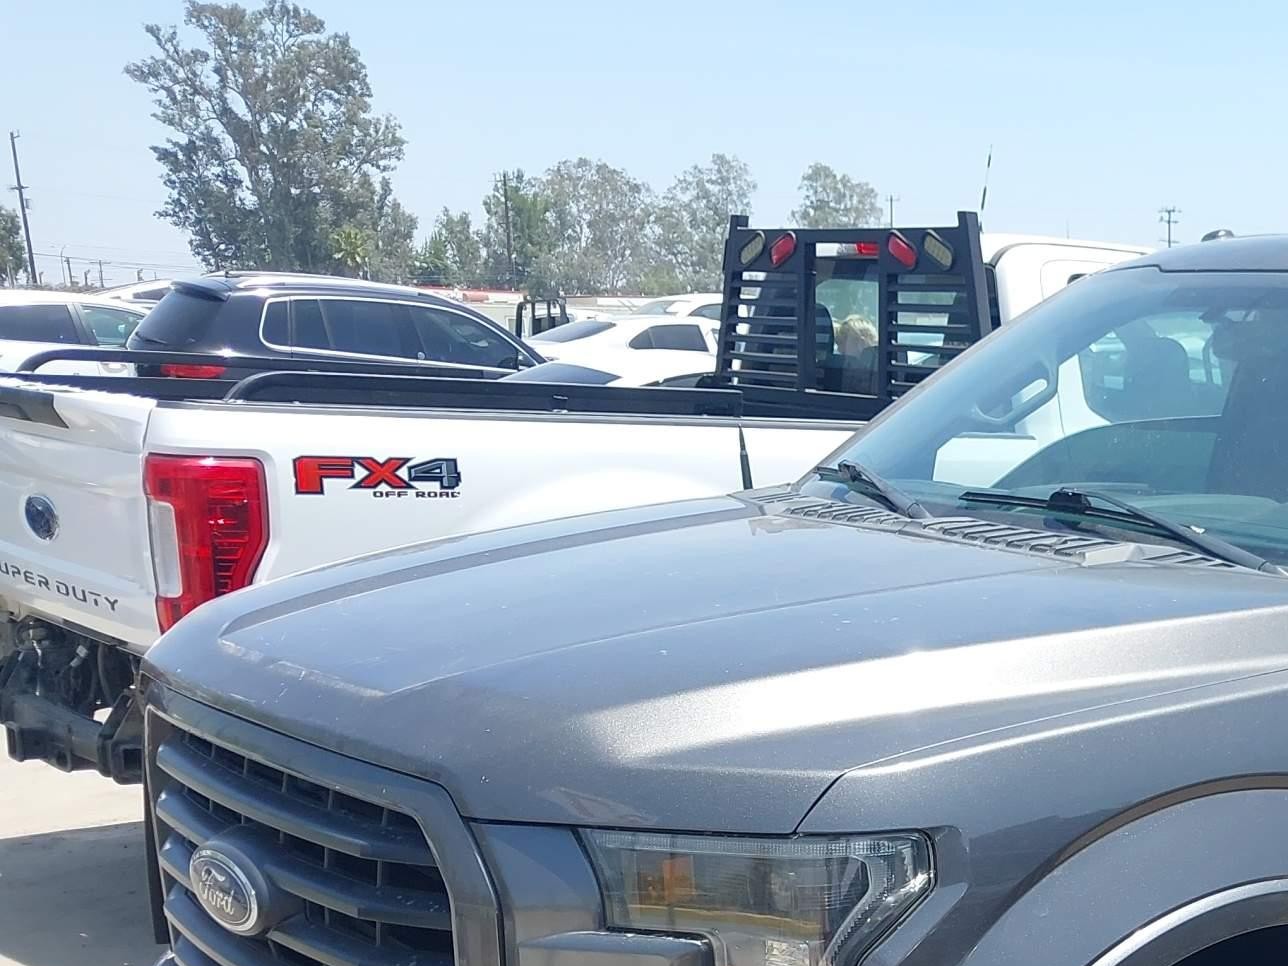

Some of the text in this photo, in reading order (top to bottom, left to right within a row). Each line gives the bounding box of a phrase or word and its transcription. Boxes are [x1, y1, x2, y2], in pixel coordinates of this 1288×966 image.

[292, 455, 462, 495] FX4
[372, 490, 409, 498] OFF
[0, 561, 119, 612] UPER DUTY
[200, 865, 235, 916] Ford
